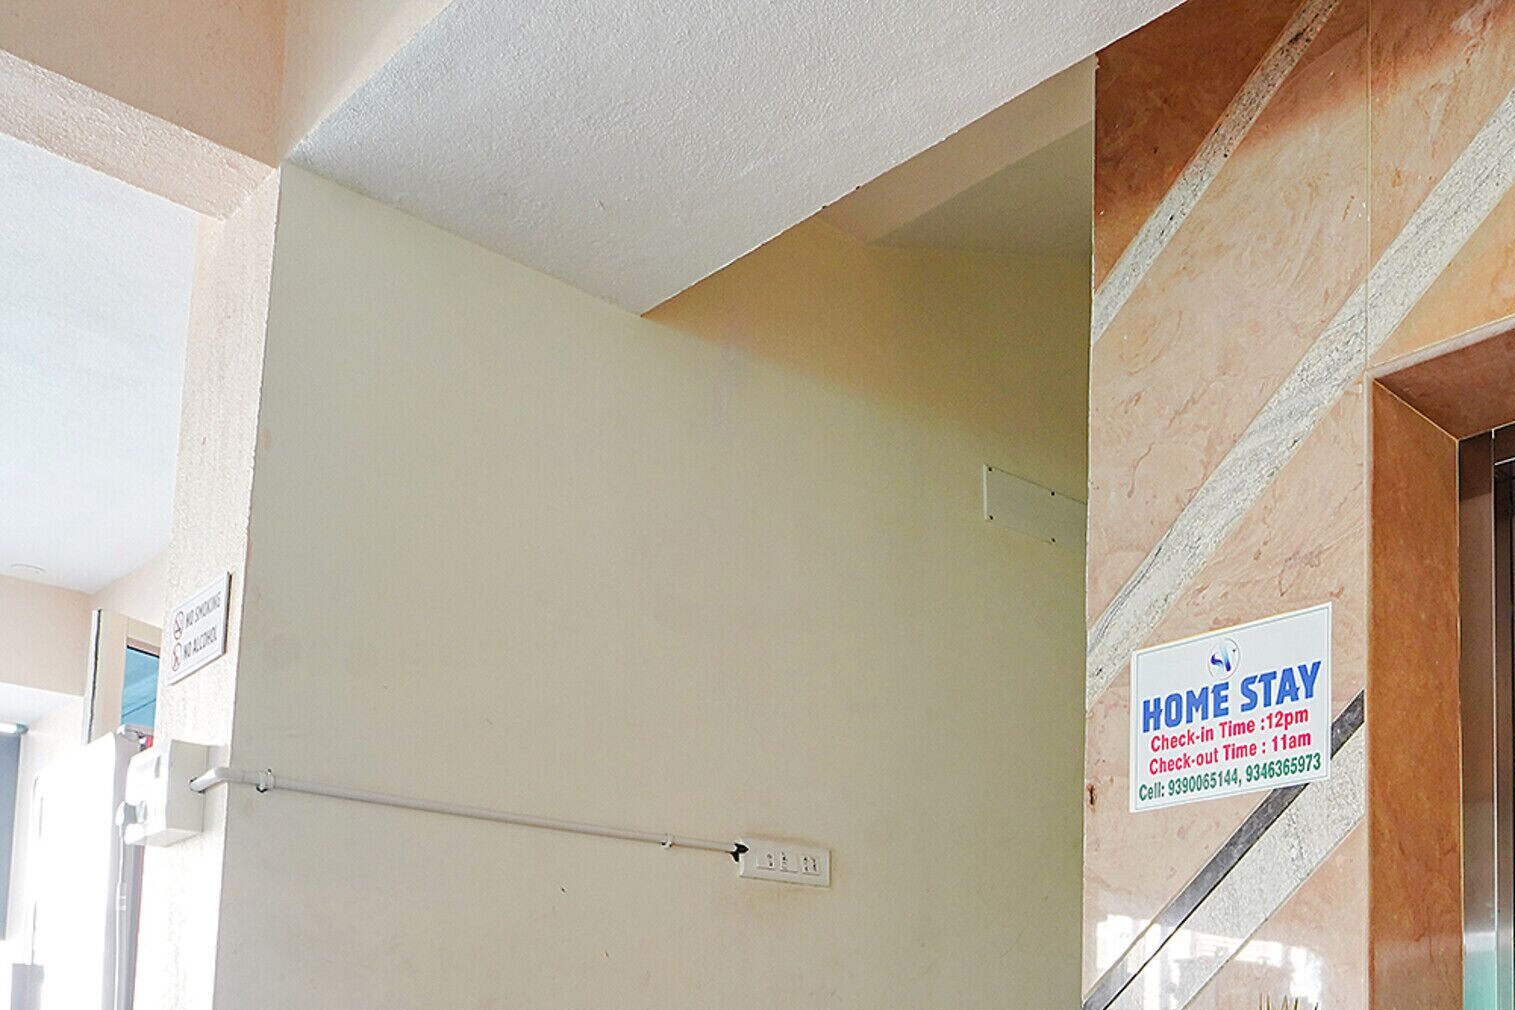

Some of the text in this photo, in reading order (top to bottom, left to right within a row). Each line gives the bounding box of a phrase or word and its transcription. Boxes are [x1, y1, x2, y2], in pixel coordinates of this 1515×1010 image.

[185, 591, 221, 628] NO SMOKING
[183, 626, 218, 660] NO ALCOHOL
[1142, 660, 1322, 733] HOME STAY
[1149, 749, 1219, 775] Check-out
[1223, 741, 1258, 766] Time
[1272, 731, 1312, 753] 11am
[1151, 725, 1214, 753] Check-in
[1219, 718, 1256, 740] Time
[1139, 752, 1322, 802] Cell: 9390065144, 9346365973
